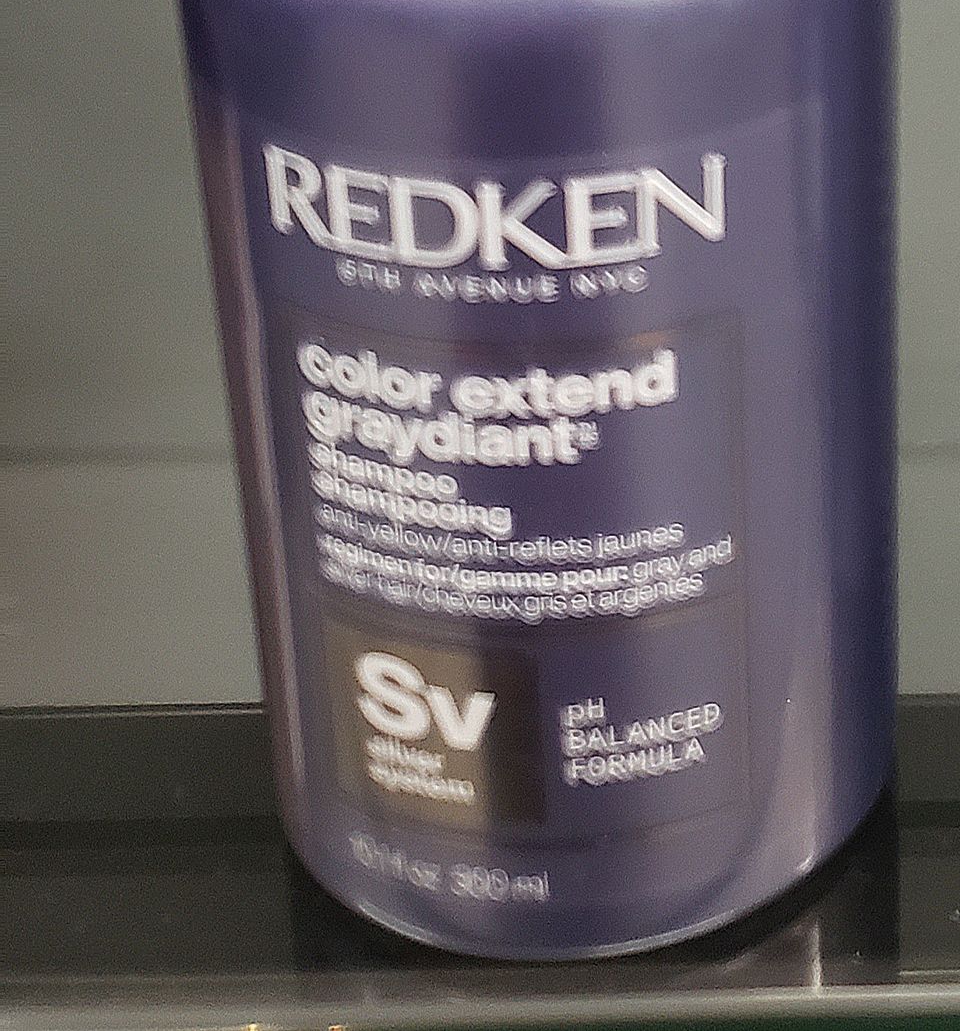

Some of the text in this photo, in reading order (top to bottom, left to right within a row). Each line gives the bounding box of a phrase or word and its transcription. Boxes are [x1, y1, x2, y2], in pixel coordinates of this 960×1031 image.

[263, 143, 727, 270] REDKEN
[413, 271, 560, 304] AVENUE
[299, 342, 679, 418] color extend
[309, 443, 459, 501] shampoo
[310, 469, 514, 540] shampooing
[596, 521, 686, 560] jaunes
[687, 534, 735, 572] and
[356, 651, 497, 751] Sv
[562, 698, 606, 728] pH
[561, 702, 723, 758] BALANCED
[563, 738, 706, 786] FORMULA
[451, 863, 509, 901] 300
